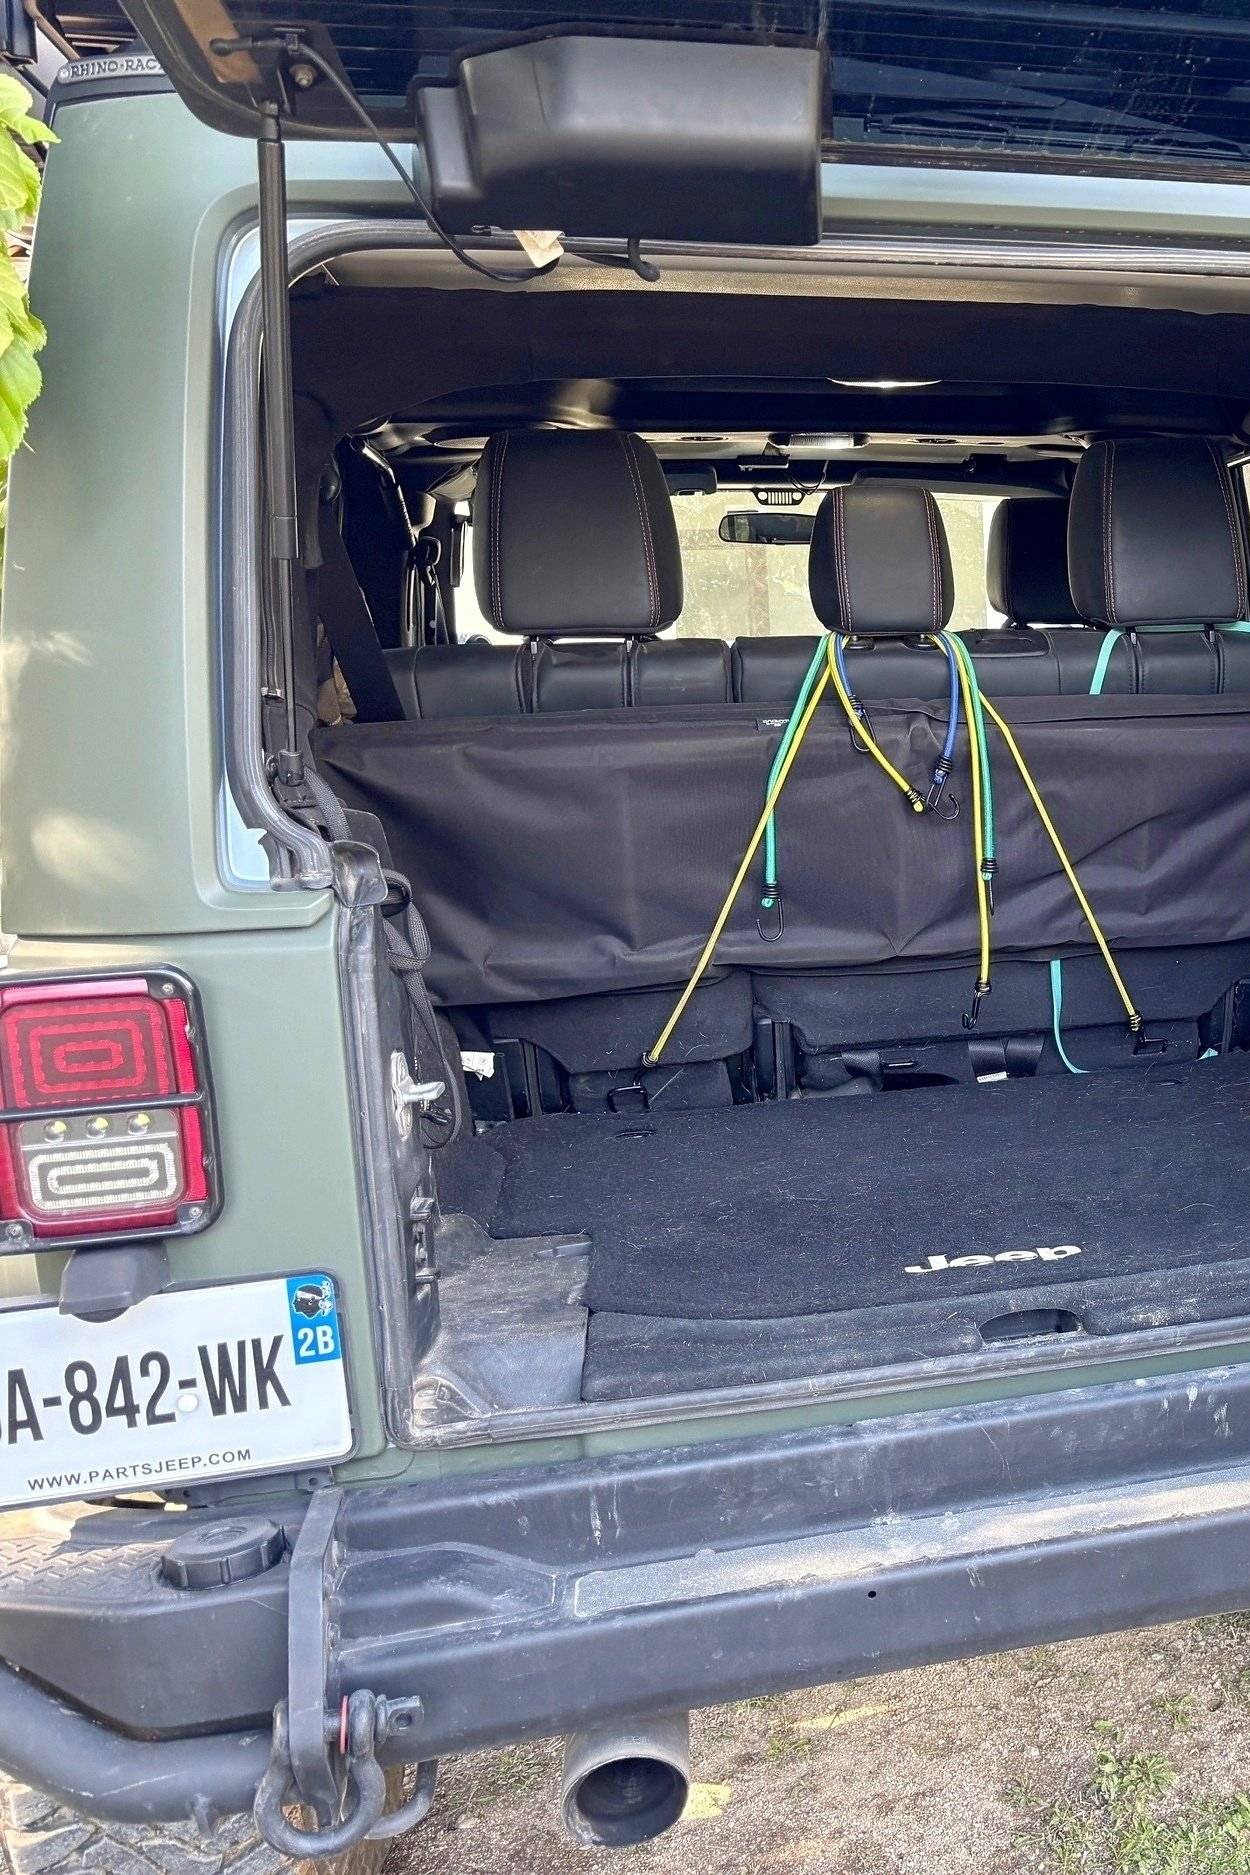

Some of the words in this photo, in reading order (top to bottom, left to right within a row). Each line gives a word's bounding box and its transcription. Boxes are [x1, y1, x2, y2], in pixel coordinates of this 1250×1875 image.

[70, 57, 162, 78] RHINO-RAC
[904, 1245, 1082, 1273] Jeep
[297, 1325, 335, 1357] 2B
[0, 1334, 292, 1445] A-842-WK
[28, 1448, 252, 1491] WWW.PARTSJEEP.COM
